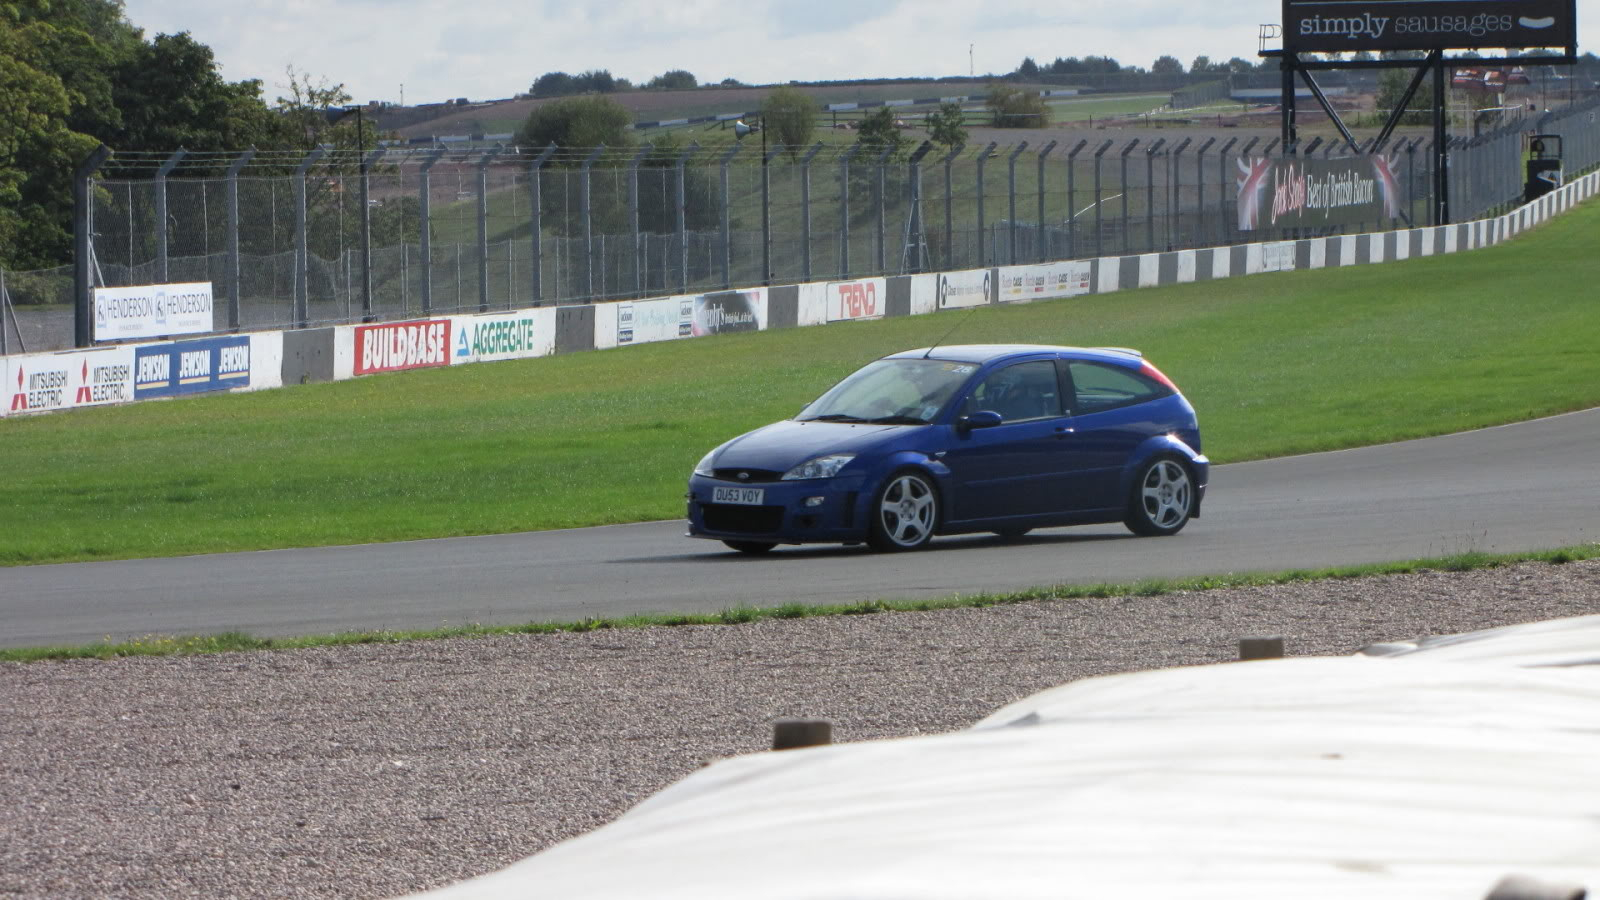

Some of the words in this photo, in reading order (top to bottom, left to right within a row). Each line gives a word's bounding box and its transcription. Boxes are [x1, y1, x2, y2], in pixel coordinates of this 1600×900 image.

[1299, 12, 1390, 39] simply
[1394, 13, 1512, 37] sausages
[1306, 174, 1322, 209] Best
[1322, 171, 1331, 219] of
[1330, 169, 1353, 208] British
[1353, 172, 1374, 205] Bacon
[107, 297, 154, 319] HENDERSON
[166, 292, 211, 315] HENDERSON
[838, 281, 876, 318] TREND
[362, 322, 445, 370] BUILDBASE
[472, 318, 534, 356] AGGREGATE
[136, 354, 170, 383] JEWSON
[179, 349, 211, 378] JEWSON
[218, 345, 249, 373] JEWSON
[29, 370, 68, 390] MITSUBISHI
[93, 364, 130, 384] MITSUBISHI
[29, 389, 62, 408] ELECTRIC
[93, 383, 125, 402] ELECTRIC
